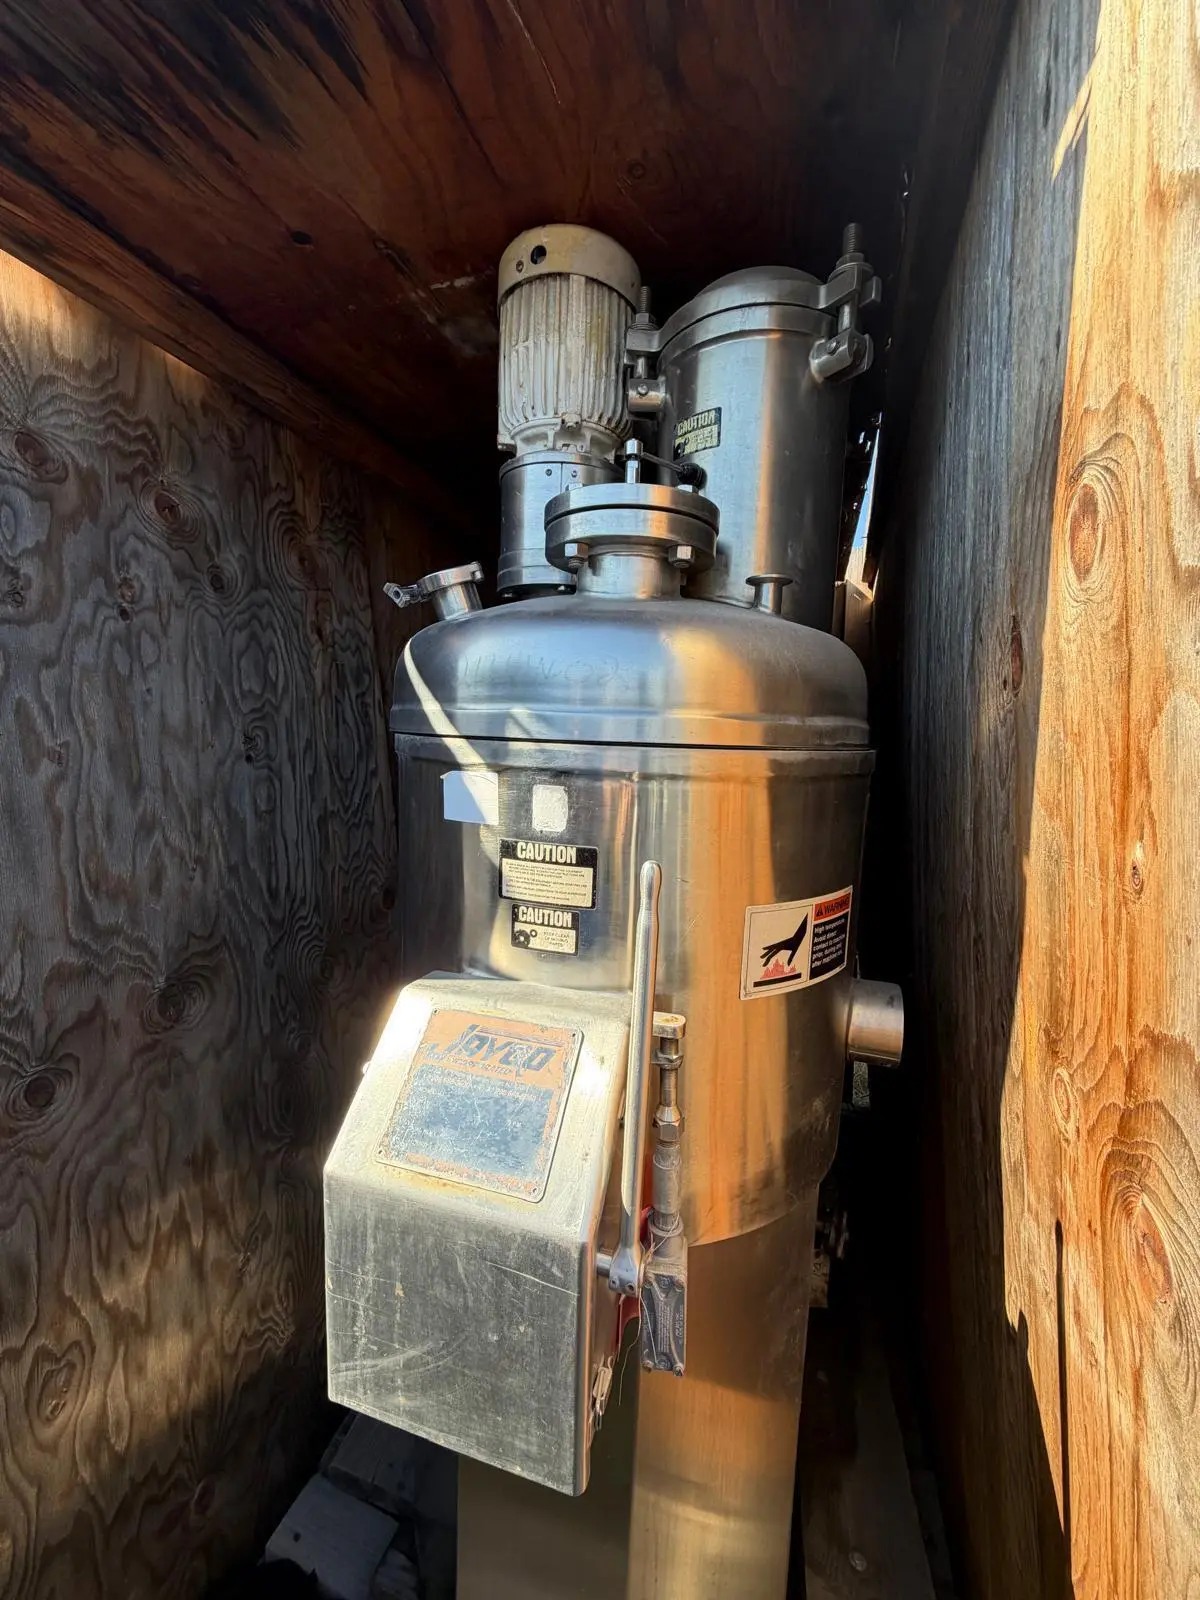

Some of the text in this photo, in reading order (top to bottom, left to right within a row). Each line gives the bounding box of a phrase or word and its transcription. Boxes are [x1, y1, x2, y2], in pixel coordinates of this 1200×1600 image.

[677, 409, 716, 436] CAUTION
[517, 842, 576, 864] CAUTION
[519, 906, 571, 927] CAUTION
